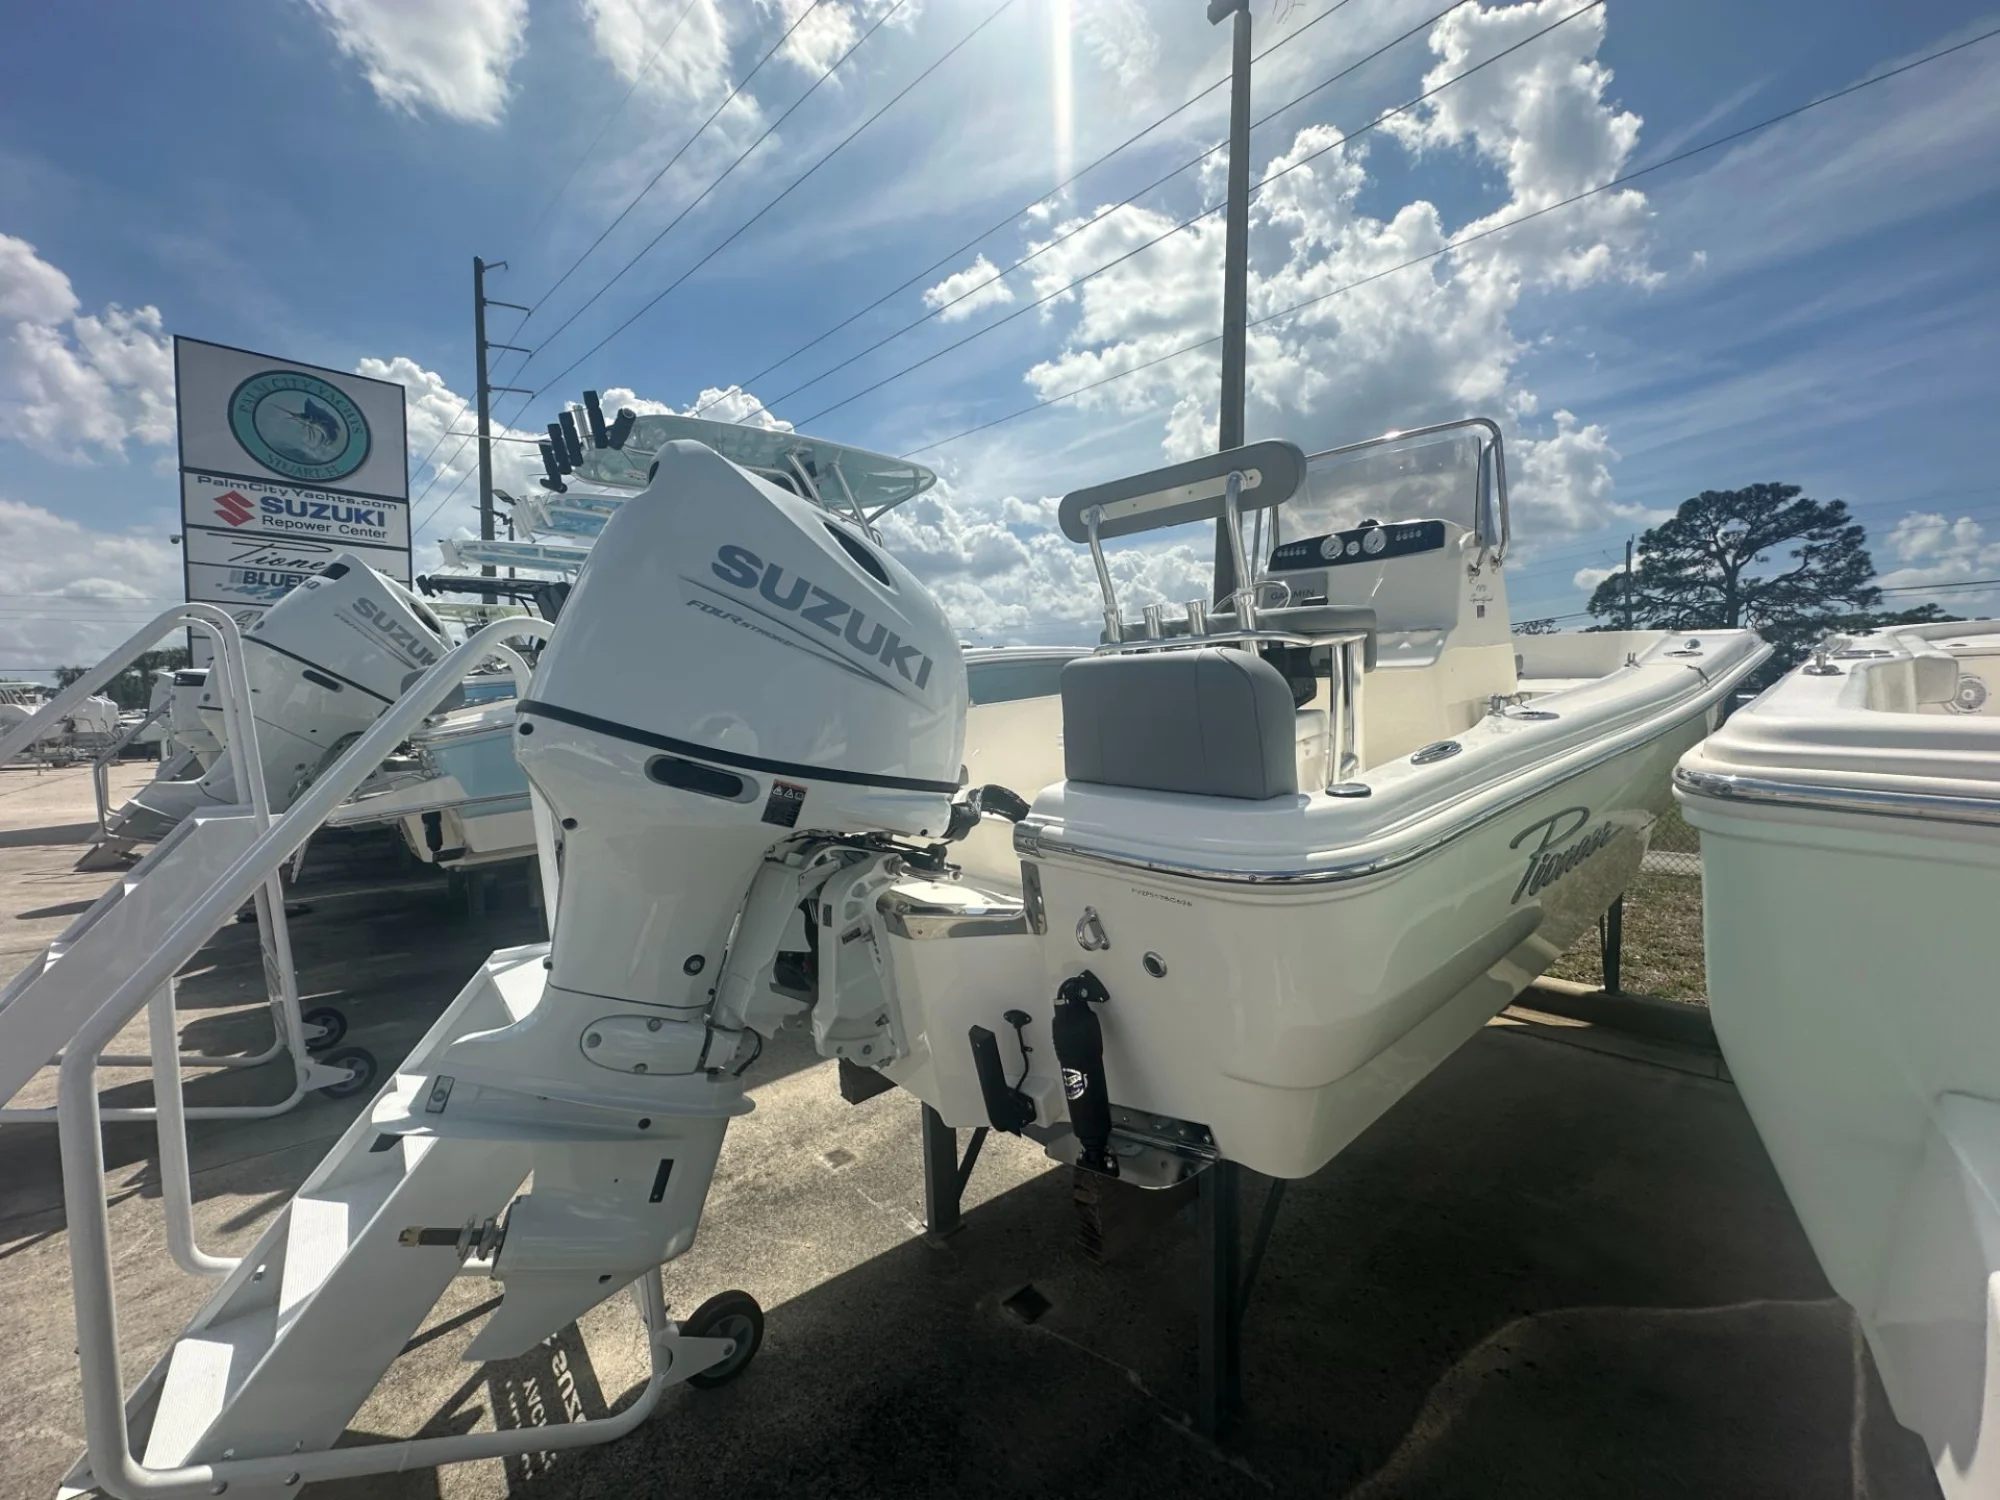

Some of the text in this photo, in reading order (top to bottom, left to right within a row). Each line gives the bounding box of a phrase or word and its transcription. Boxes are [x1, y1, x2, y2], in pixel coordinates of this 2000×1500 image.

[272, 378, 312, 391] CITY
[318, 385, 363, 434] YACHTS
[259, 496, 385, 527] SUZUKI
[261, 515, 387, 539] Repower Center
[206, 532, 333, 570] Pione
[352, 597, 438, 666] SUZUK
[711, 544, 933, 691] SUZUKI
